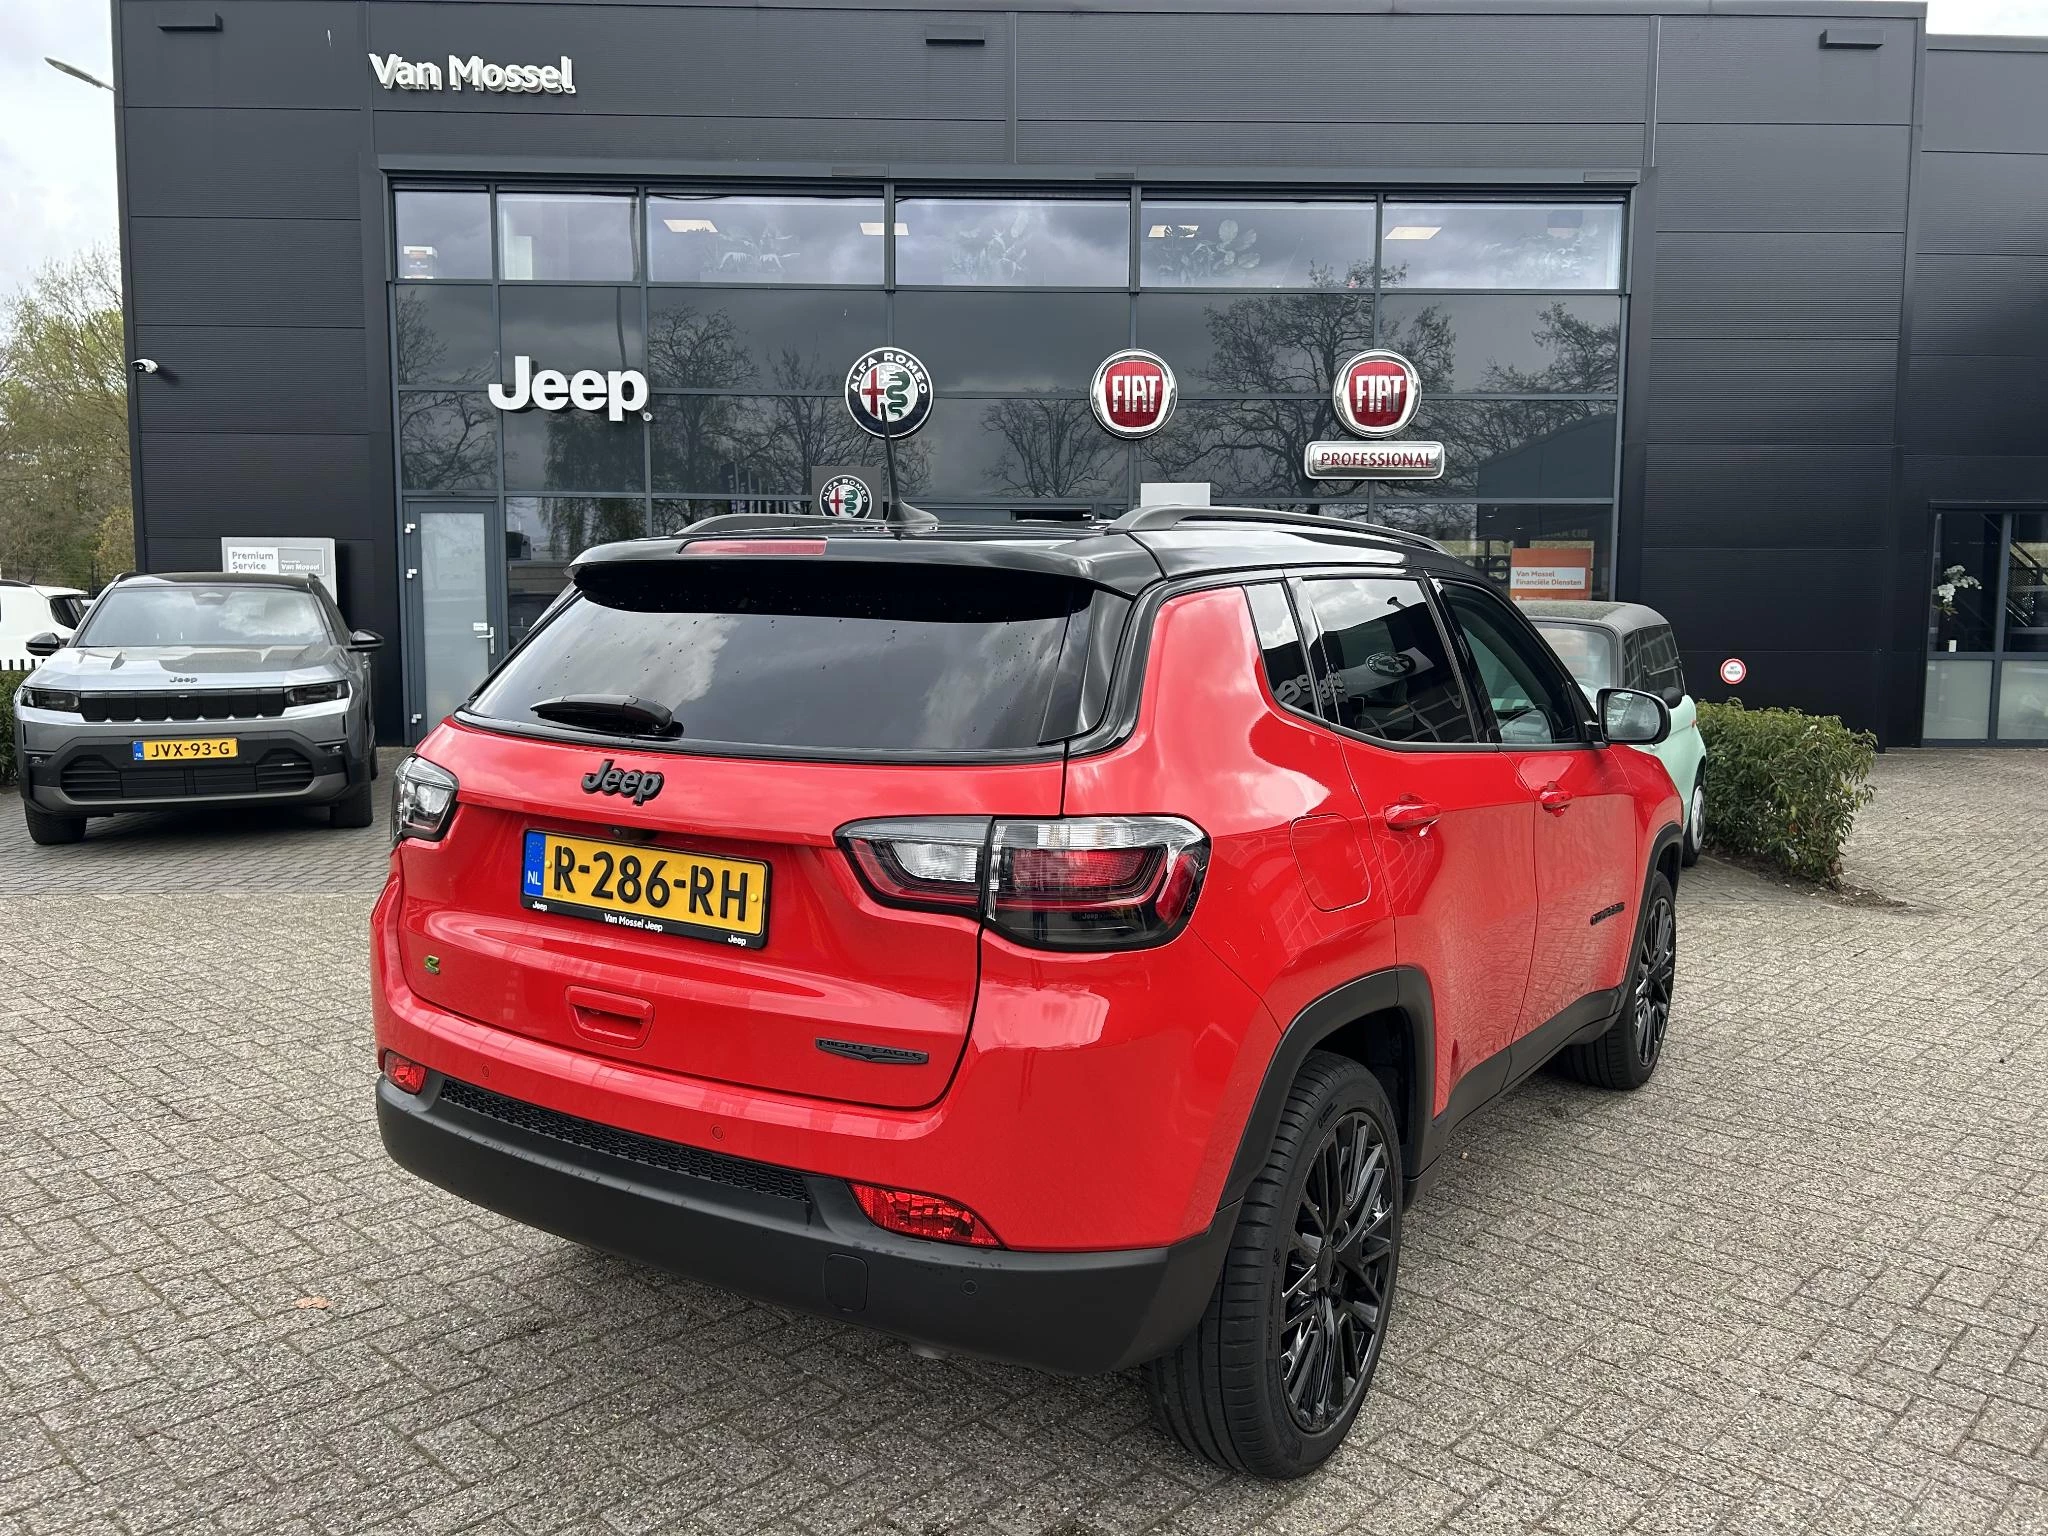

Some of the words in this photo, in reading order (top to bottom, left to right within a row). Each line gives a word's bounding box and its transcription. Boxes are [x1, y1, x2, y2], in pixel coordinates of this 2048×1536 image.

[368, 53, 443, 91] Van
[449, 54, 576, 95] Mossel
[850, 356, 878, 393] ALFA
[883, 352, 928, 394] ROMEO
[488, 355, 648, 421] Jeep
[1112, 375, 1160, 413] FIAT
[1355, 375, 1404, 413] FIAT
[1321, 452, 1433, 468] PROFESSIONAL
[823, 481, 839, 502] ALFA
[842, 478, 868, 503] ROMEO
[232, 551, 274, 560] Premium
[232, 562, 267, 570] Service
[169, 676, 198, 684] Jeep
[151, 741, 230, 758] JVX-93-G
[581, 758, 665, 806] Jeep
[527, 870, 542, 886] NL
[553, 845, 748, 922] R-286-RH
[532, 901, 548, 912] Jeep
[604, 912, 618, 924] Van
[618, 915, 644, 928] Mossel
[644, 920, 663, 932] Jeep
[728, 934, 747, 947] Jeep
